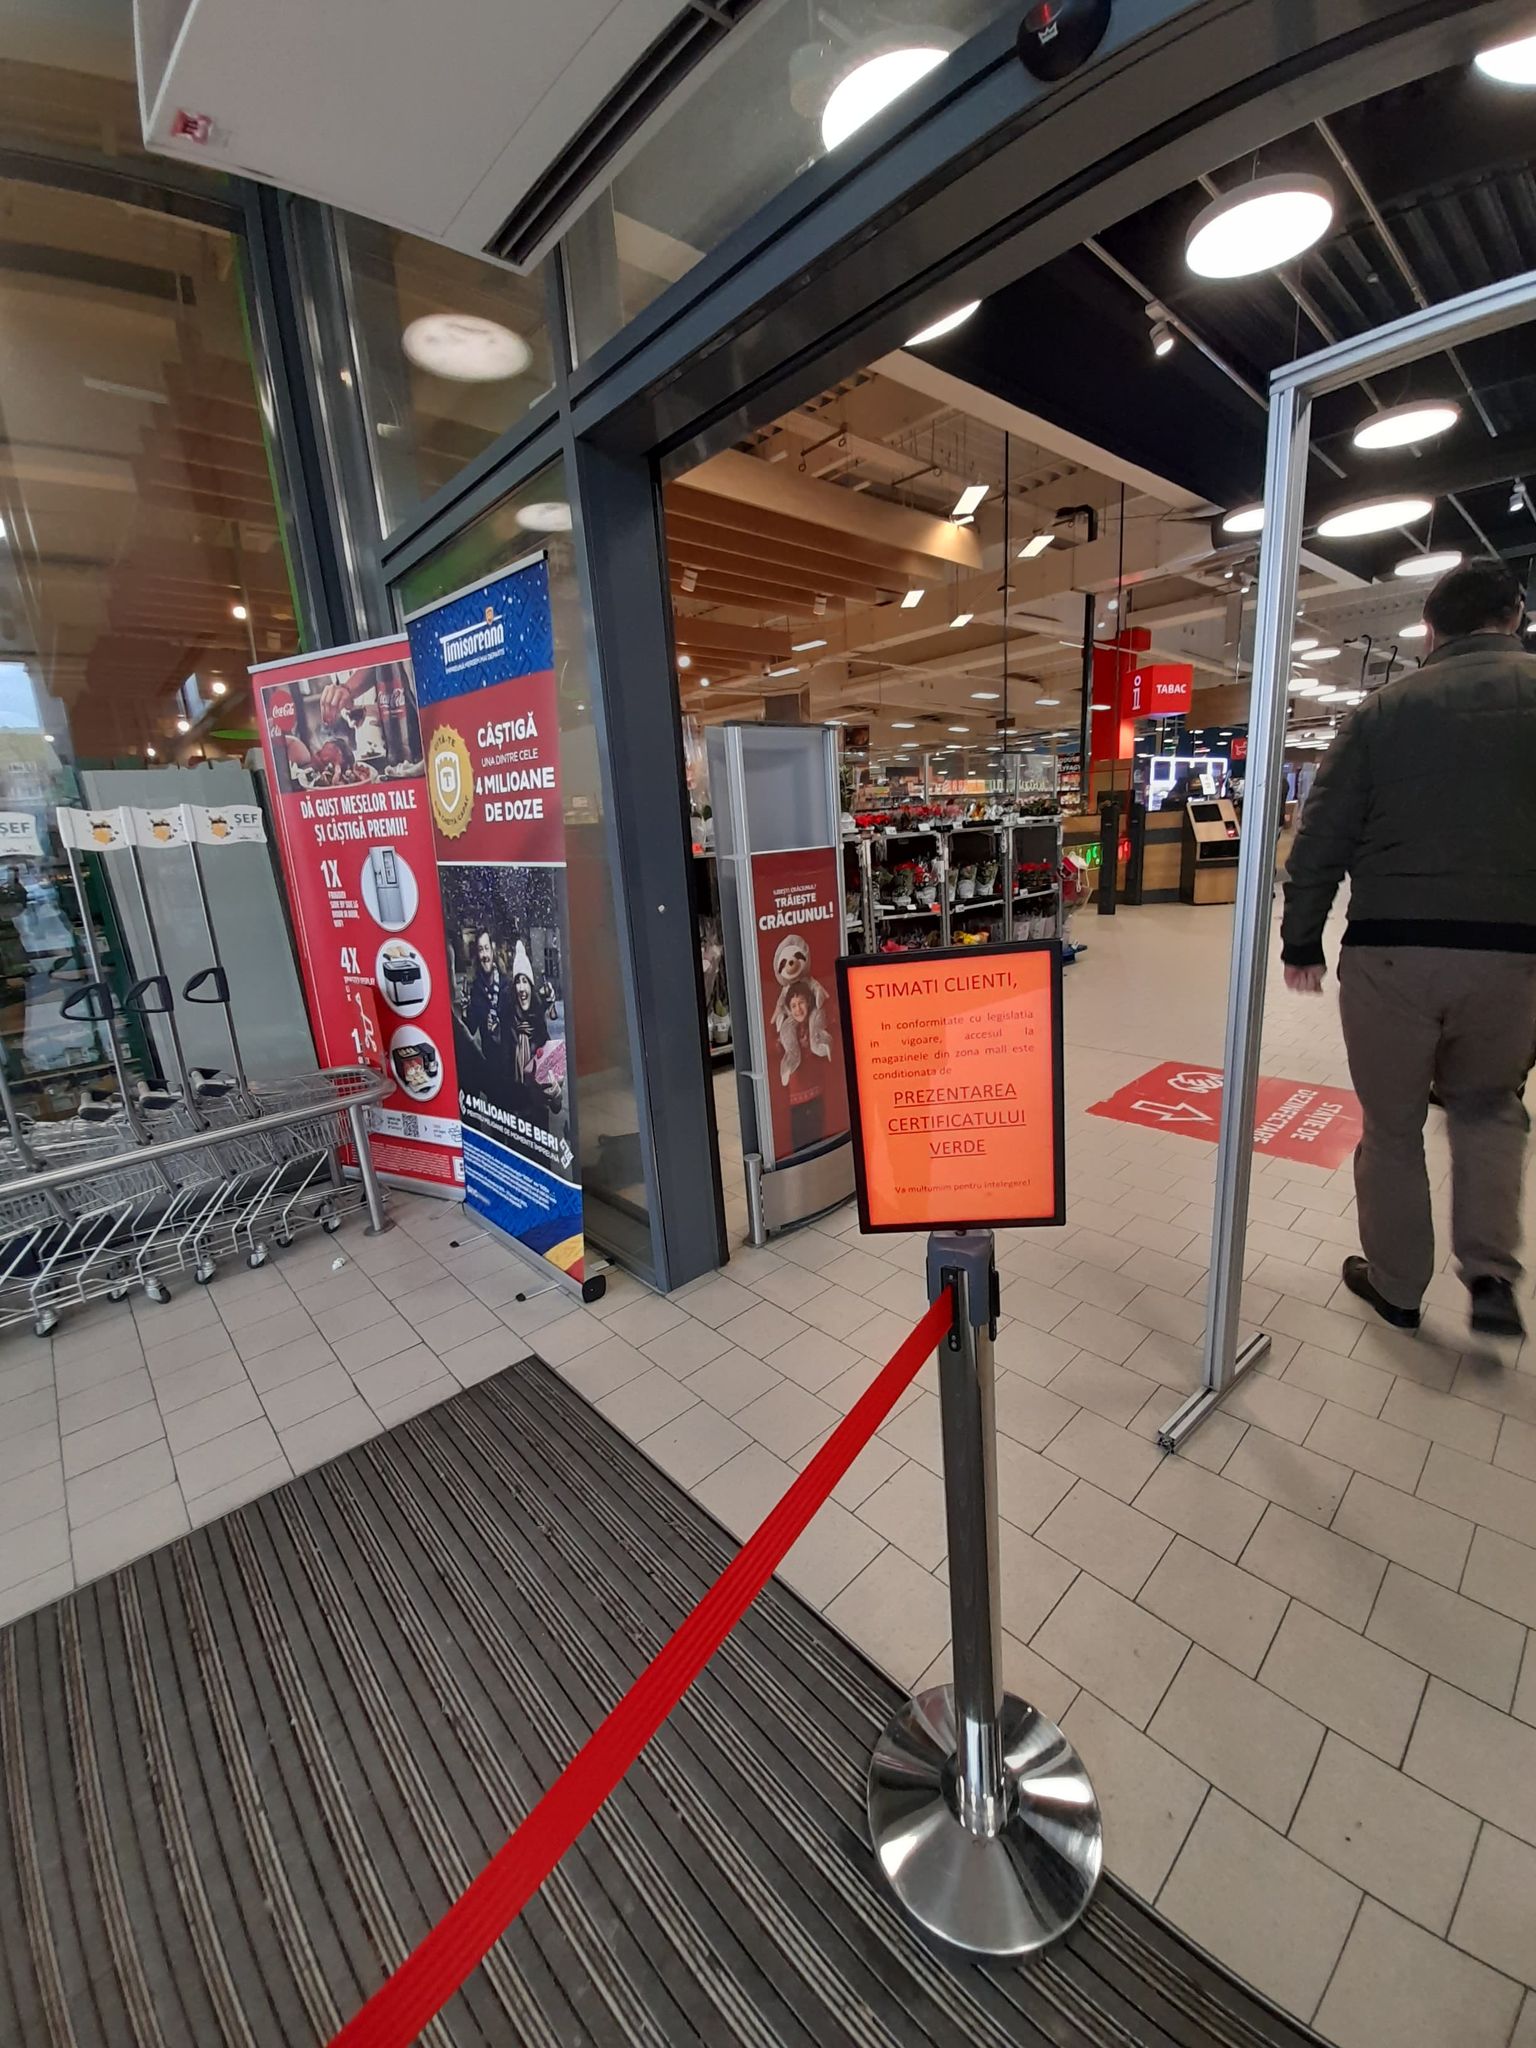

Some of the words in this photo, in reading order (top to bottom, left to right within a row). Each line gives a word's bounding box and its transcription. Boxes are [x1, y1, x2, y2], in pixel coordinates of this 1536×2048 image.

[1156, 684, 1187, 694] TABAC
[481, 756, 496, 767] UNA
[495, 752, 519, 765] DINTRE
[519, 748, 538, 760] CELE
[475, 777, 483, 795] 4
[484, 767, 555, 794] MILIOANE
[300, 795, 315, 819] DĂ
[316, 798, 339, 818] GUST
[341, 793, 387, 815] MESELOR
[388, 789, 417, 810] TALE
[485, 802, 503, 822] DE
[505, 798, 544, 820] DOZE
[314, 824, 325, 847] ȘI
[367, 817, 408, 838] PREMII!
[321, 860, 342, 888] 1X
[774, 893, 816, 907] TRĂIEȘTE
[759, 901, 834, 931] CRĂCIUNUL!
[341, 947, 360, 974] 4X
[865, 979, 938, 999] STIMATI
[944, 972, 1017, 992] CLIENTI,
[881, 1022, 891, 1031] In
[896, 1017, 964, 1030] conformitate
[969, 1015, 981, 1023] cu
[987, 1010, 1034, 1023] legislatia
[870, 1040, 880, 1048] in
[901, 1035, 943, 1047] vigoare,
[964, 1029, 1002, 1041] accesul
[1024, 1027, 1034, 1036] la
[871, 1052, 929, 1065] magazinele
[934, 1049, 950, 1060] din
[955, 1047, 979, 1058] zona
[984, 1044, 1007, 1055] mall
[1012, 1044, 1034, 1053] este
[872, 1066, 936, 1081] conditionata
[939, 1064, 952, 1076] de
[894, 1083, 1017, 1105] PREZENTAREA
[466, 1094, 472, 1107] 4
[472, 1097, 517, 1130] MILIOANE
[518, 1119, 533, 1137] DE
[533, 1126, 558, 1151] BERI
[888, 1110, 1025, 1132] CERTIFICATULUI
[1253, 1089, 1318, 1145] DEZINFECTARE
[1290, 1127, 1320, 1142] DE
[929, 1139, 985, 1155] VERDE
